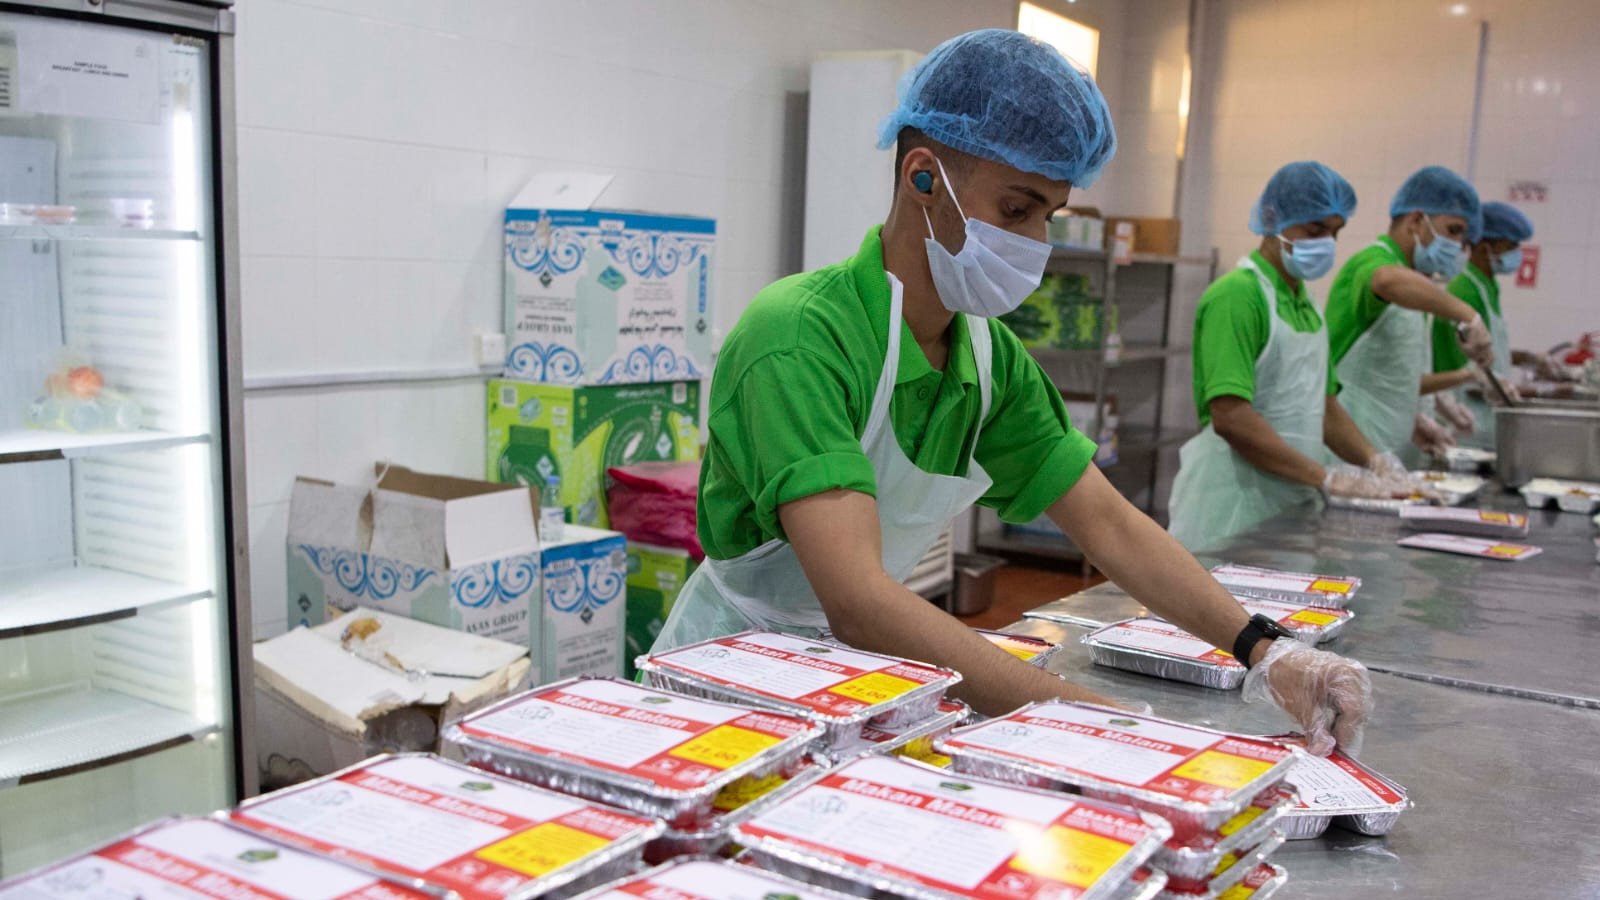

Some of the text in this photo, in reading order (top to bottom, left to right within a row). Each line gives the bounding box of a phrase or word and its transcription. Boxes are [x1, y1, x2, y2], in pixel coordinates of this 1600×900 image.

[731, 641, 788, 659] Makan
[787, 655, 846, 673] Malam
[554, 694, 689, 729] Makan Malam
[1026, 717, 1173, 751] Makan Malam
[360, 775, 508, 825] Makan Malam
[840, 778, 924, 808] Makan
